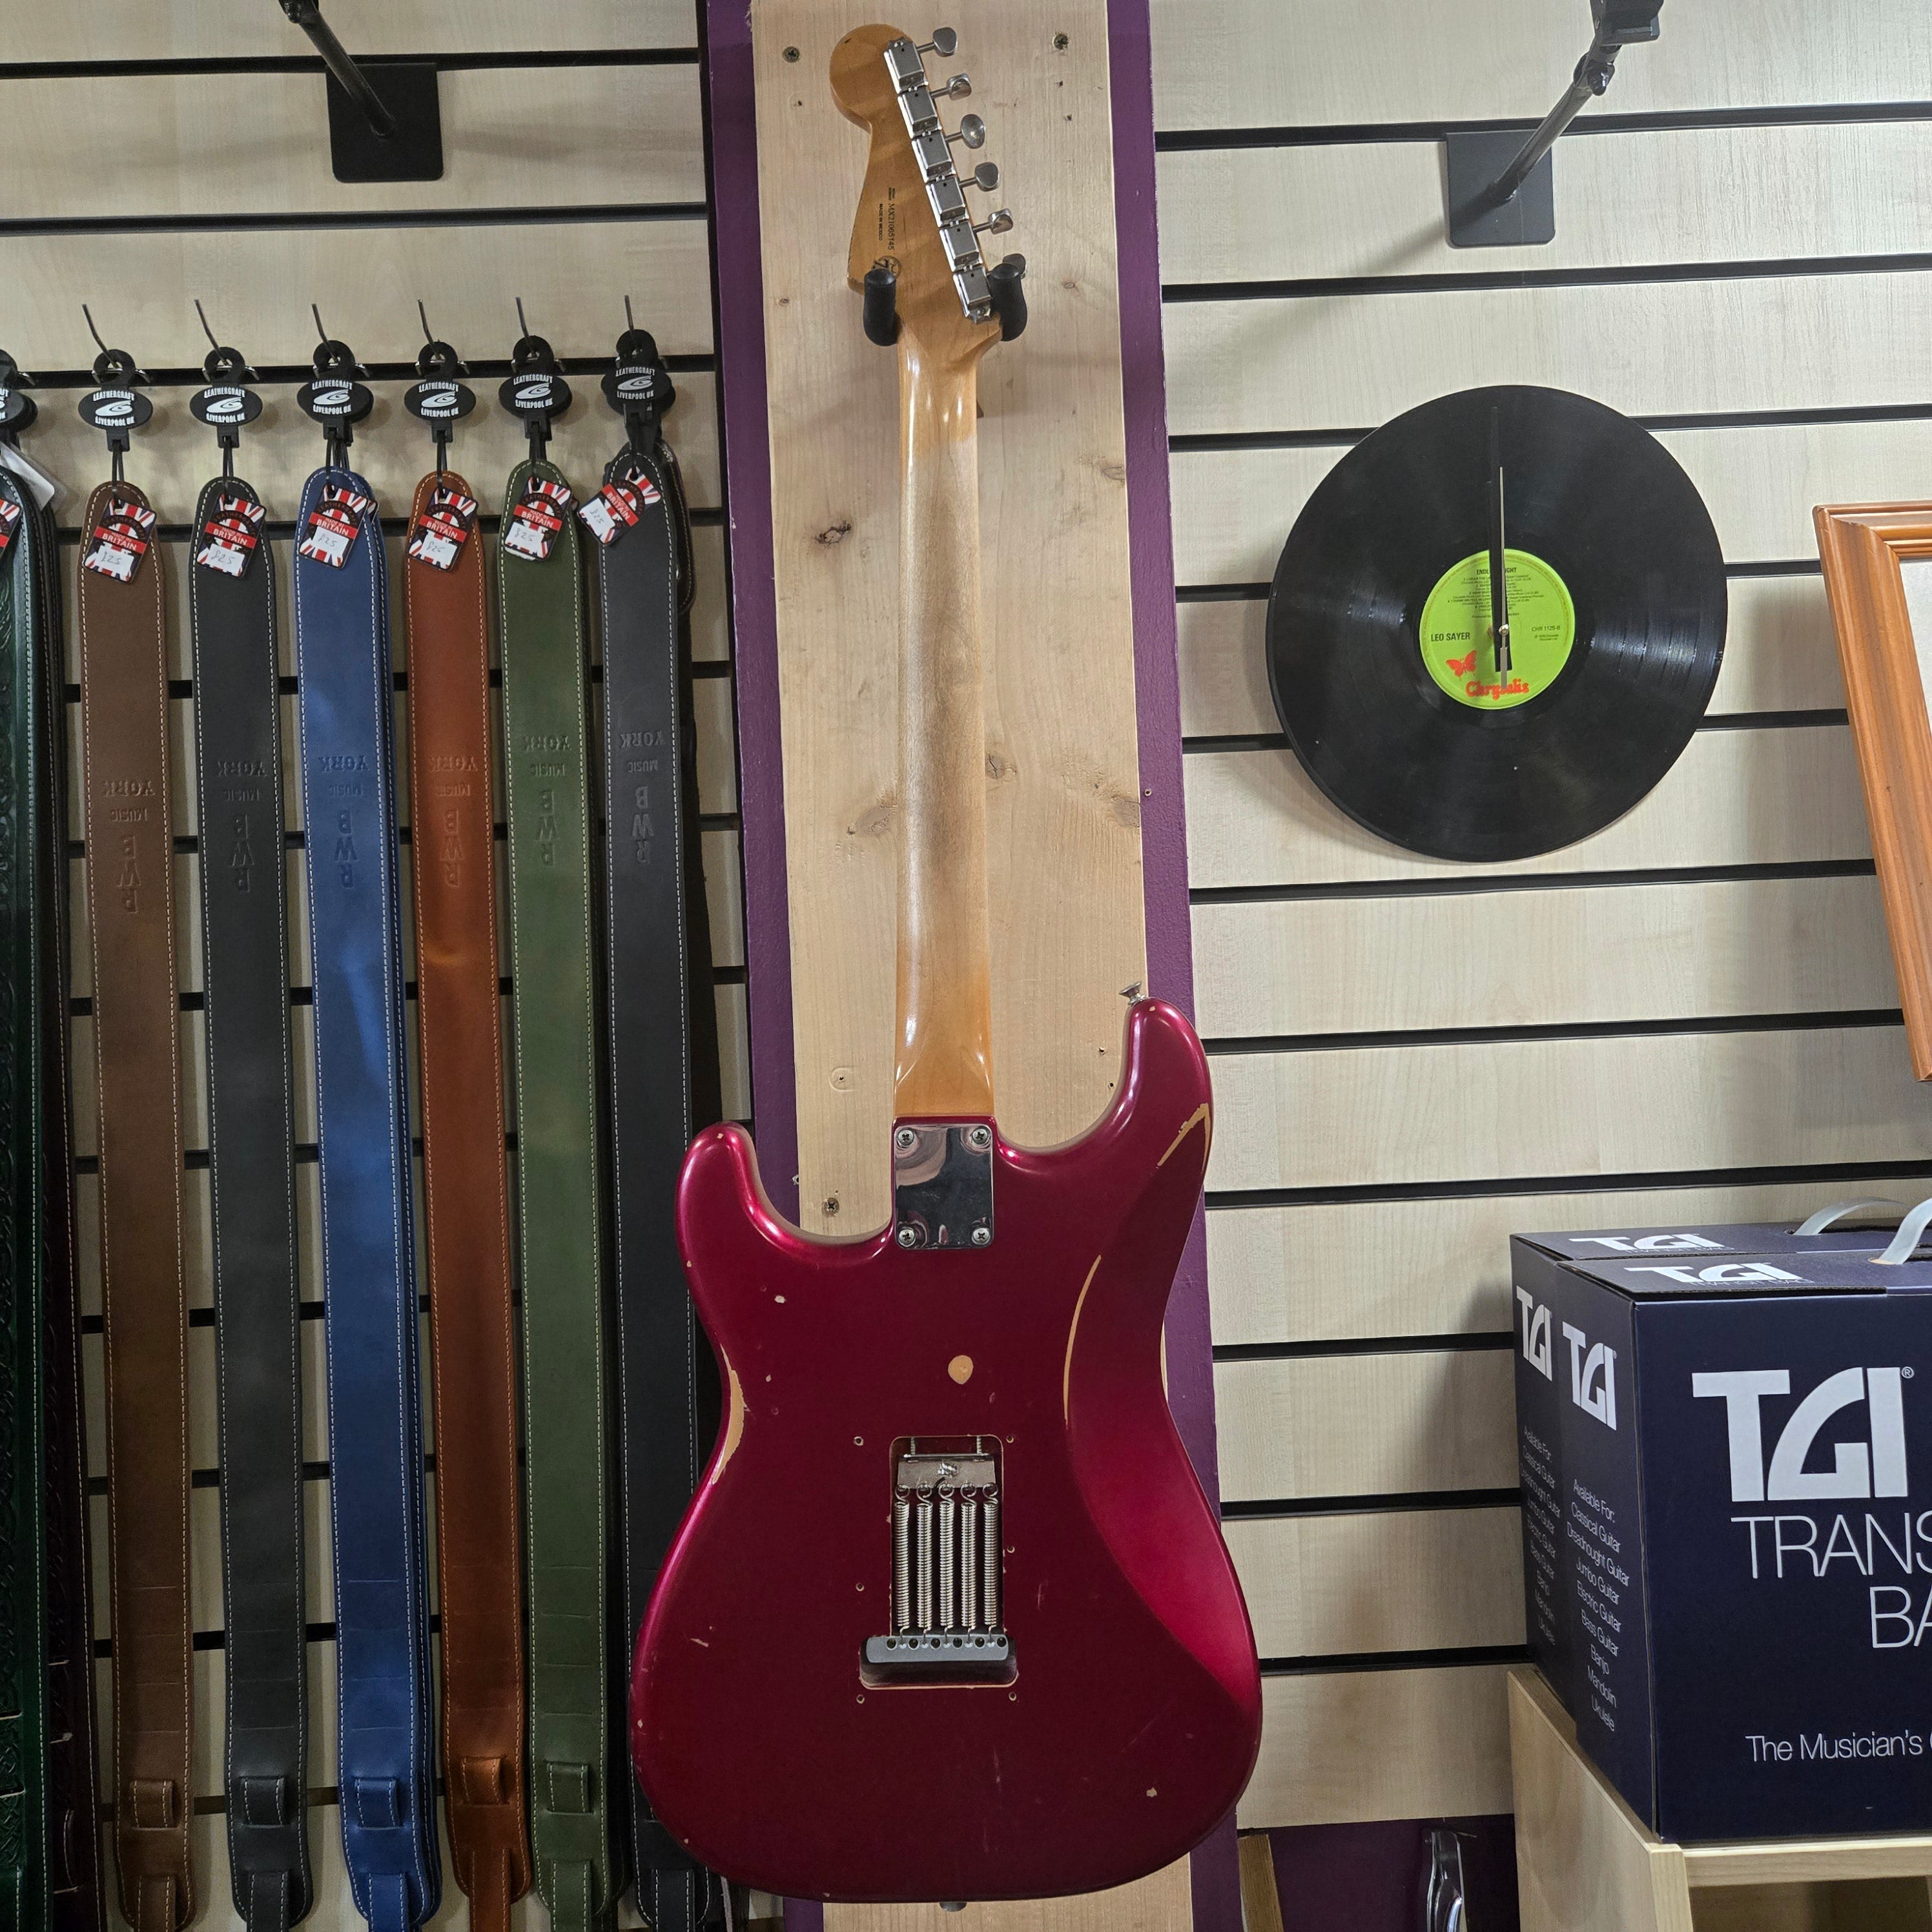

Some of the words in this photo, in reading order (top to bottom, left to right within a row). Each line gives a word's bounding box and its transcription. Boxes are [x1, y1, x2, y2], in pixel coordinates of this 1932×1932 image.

[513, 374, 553, 385] LEATHERCRAFT
[615, 367, 655, 376] LEATHERCRAFT
[204, 387, 245, 398] LEATHERCRAFT
[312, 379, 353, 390] LEATHERCRAFT
[418, 382, 459, 393] LEATHERCRAFT
[93, 390, 134, 401] LEATHERCRAFT
[515, 399, 545, 408] LIVERPOOL
[545, 398, 553, 406] UK
[617, 391, 645, 399] LIVERPOOL
[206, 413, 236, 423] LIVERPOOL
[237, 413, 245, 421] UK
[313, 404, 343, 415] LIVERPOOL
[343, 404, 351, 413] UK
[420, 407, 451, 417] LIVERPOOL
[451, 407, 459, 416] UK
[95, 416, 126, 426] LIVERPOOL
[126, 416, 134, 425] UK
[607, 493, 631, 520] BRITAIN
[316, 519, 349, 536] BRITAIN
[521, 511, 553, 528] BRITAIN
[213, 529, 247, 546] BRITAIN
[427, 521, 457, 539] BRITAIN
[102, 533, 137, 550] BRITAIN
[1446, 632, 1471, 641] SAYER
[523, 735, 572, 753] YORK
[619, 730, 664, 748] YORK
[216, 760, 268, 777] YORK
[318, 754, 370, 773] YORK
[427, 755, 478, 772] YORK
[530, 763, 566, 777] MUSIC
[628, 759, 658, 774] MUSIC
[102, 779, 156, 797] YORK
[224, 788, 260, 802] MUSIC
[329, 783, 364, 797] MUSIC
[435, 783, 471, 797] MUSIC
[110, 808, 148, 822] MUSIC
[1569, 1234, 1725, 1251] TGI
[1624, 1263, 1804, 1282] TGI
[1517, 1286, 1552, 1381] TGI
[1574, 1479, 1600, 1512] Available
[1601, 1499, 1615, 1523] For:
[1572, 1501, 1598, 1536] Classical
[1599, 1525, 1621, 1553] Guitar
[1567, 1521, 1606, 1569] Dreadnought
[1607, 1557, 1630, 1587] Guitar
[1576, 1557, 1597, 1587] Jumbo
[1598, 1576, 1619, 1605] Guitar
[1577, 1580, 1598, 1614] Electric
[1599, 1603, 1621, 1633] Guitar
[1581, 1608, 1597, 1637] Bass
[1597, 1627, 1618, 1657] Guitar
[1590, 1644, 1609, 1675] Banjo
[1587, 1665, 1616, 1708] Mandolin
[1591, 1694, 1614, 1732] Ukulele
[1745, 1735, 1793, 1762] The
[1800, 1729, 1923, 1760] Musician's
